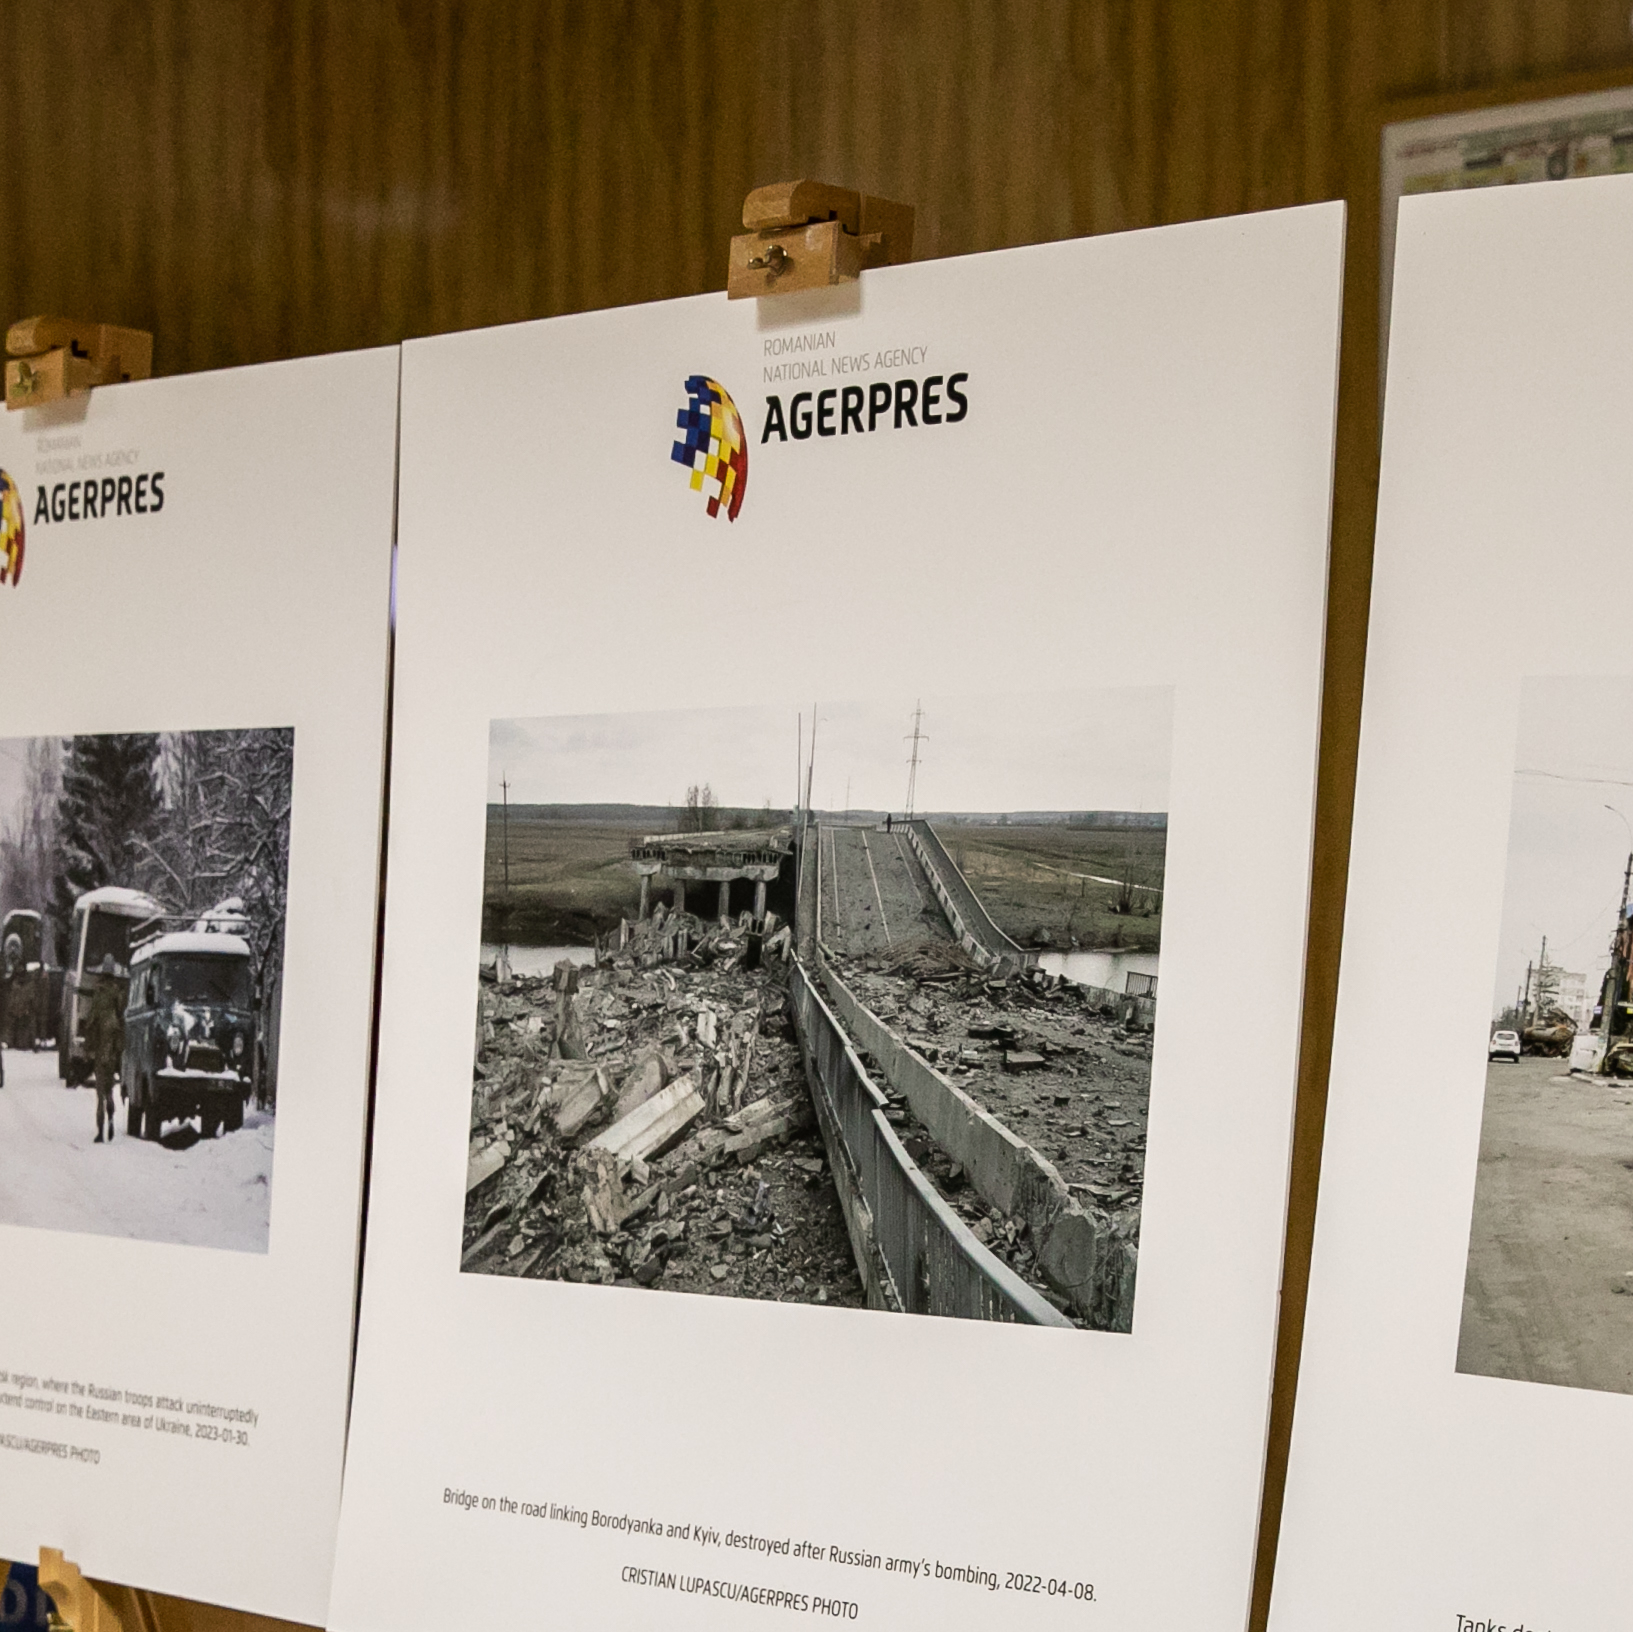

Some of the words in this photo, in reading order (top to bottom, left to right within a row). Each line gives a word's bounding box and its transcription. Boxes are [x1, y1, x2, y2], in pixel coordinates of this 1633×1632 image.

[763, 360, 827, 383] NATIONAL
[832, 353, 870, 374] NEWS
[874, 346, 927, 369] AGENCY
[764, 331, 835, 356] ROMANIAN
[761, 373, 968, 444] AGERPRES
[34, 472, 164, 524] AGERPRES
[88, 1384, 122, 1401] Russian
[186, 1403, 258, 1427] uninterruptedly
[444, 1488, 478, 1510] Bridge
[482, 1497, 496, 1509] on
[500, 1497, 518, 1513] the
[521, 1503, 547, 1518] road
[550, 1504, 588, 1528] linking
[591, 1510, 663, 1536] Borodyanka
[666, 1524, 690, 1539] and
[693, 1526, 721, 1547] Kyiv,
[725, 1530, 790, 1556] destroyed
[793, 1541, 825, 1560] after
[829, 1545, 881, 1568] Russian
[935, 1560, 1000, 1591] bombing,
[1005, 1572, 1096, 1601] 2022-04-08.
[622, 1566, 676, 1589] CRISTIAN
[680, 1576, 809, 1611] LUPASCU/AGERPRES
[812, 1597, 858, 1619] PHOTO
